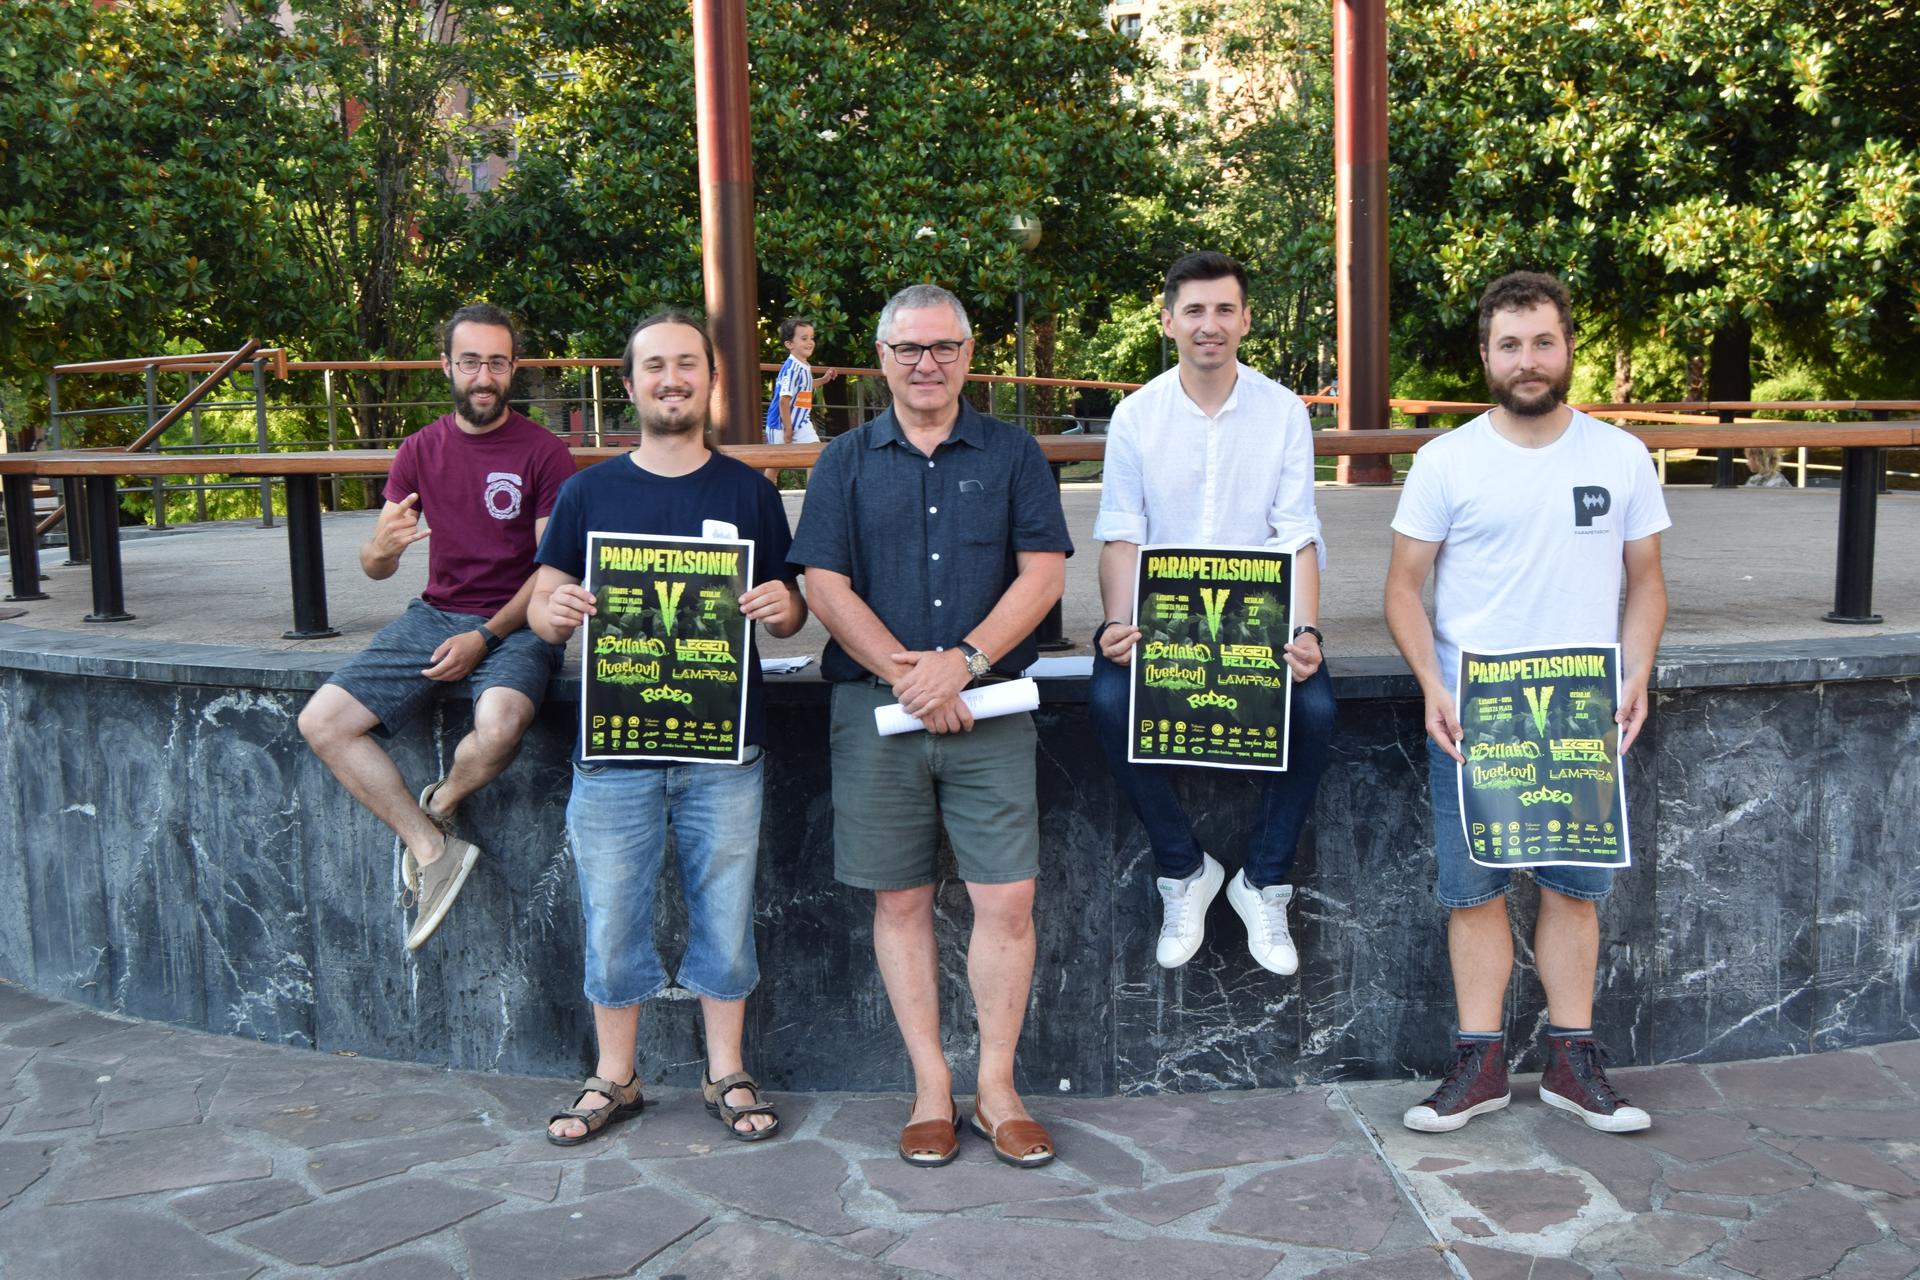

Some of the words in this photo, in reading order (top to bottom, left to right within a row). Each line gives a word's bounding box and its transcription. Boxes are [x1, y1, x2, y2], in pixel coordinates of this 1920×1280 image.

[600, 545, 739, 576] PARAPETASONIK
[1147, 556, 1282, 583] PARAPETASONIK
[653, 580, 686, 637] V
[704, 599, 715, 611] 27
[1200, 587, 1231, 642] V
[1248, 606, 1259, 616] 27
[1468, 655, 1606, 684] PARAPETASONIK
[640, 684, 693, 704] RODEO
[1187, 689, 1238, 710] RODEO
[1575, 700, 1586, 710] 27
[1523, 685, 1555, 738] V
[1518, 785, 1573, 807] RODEO
